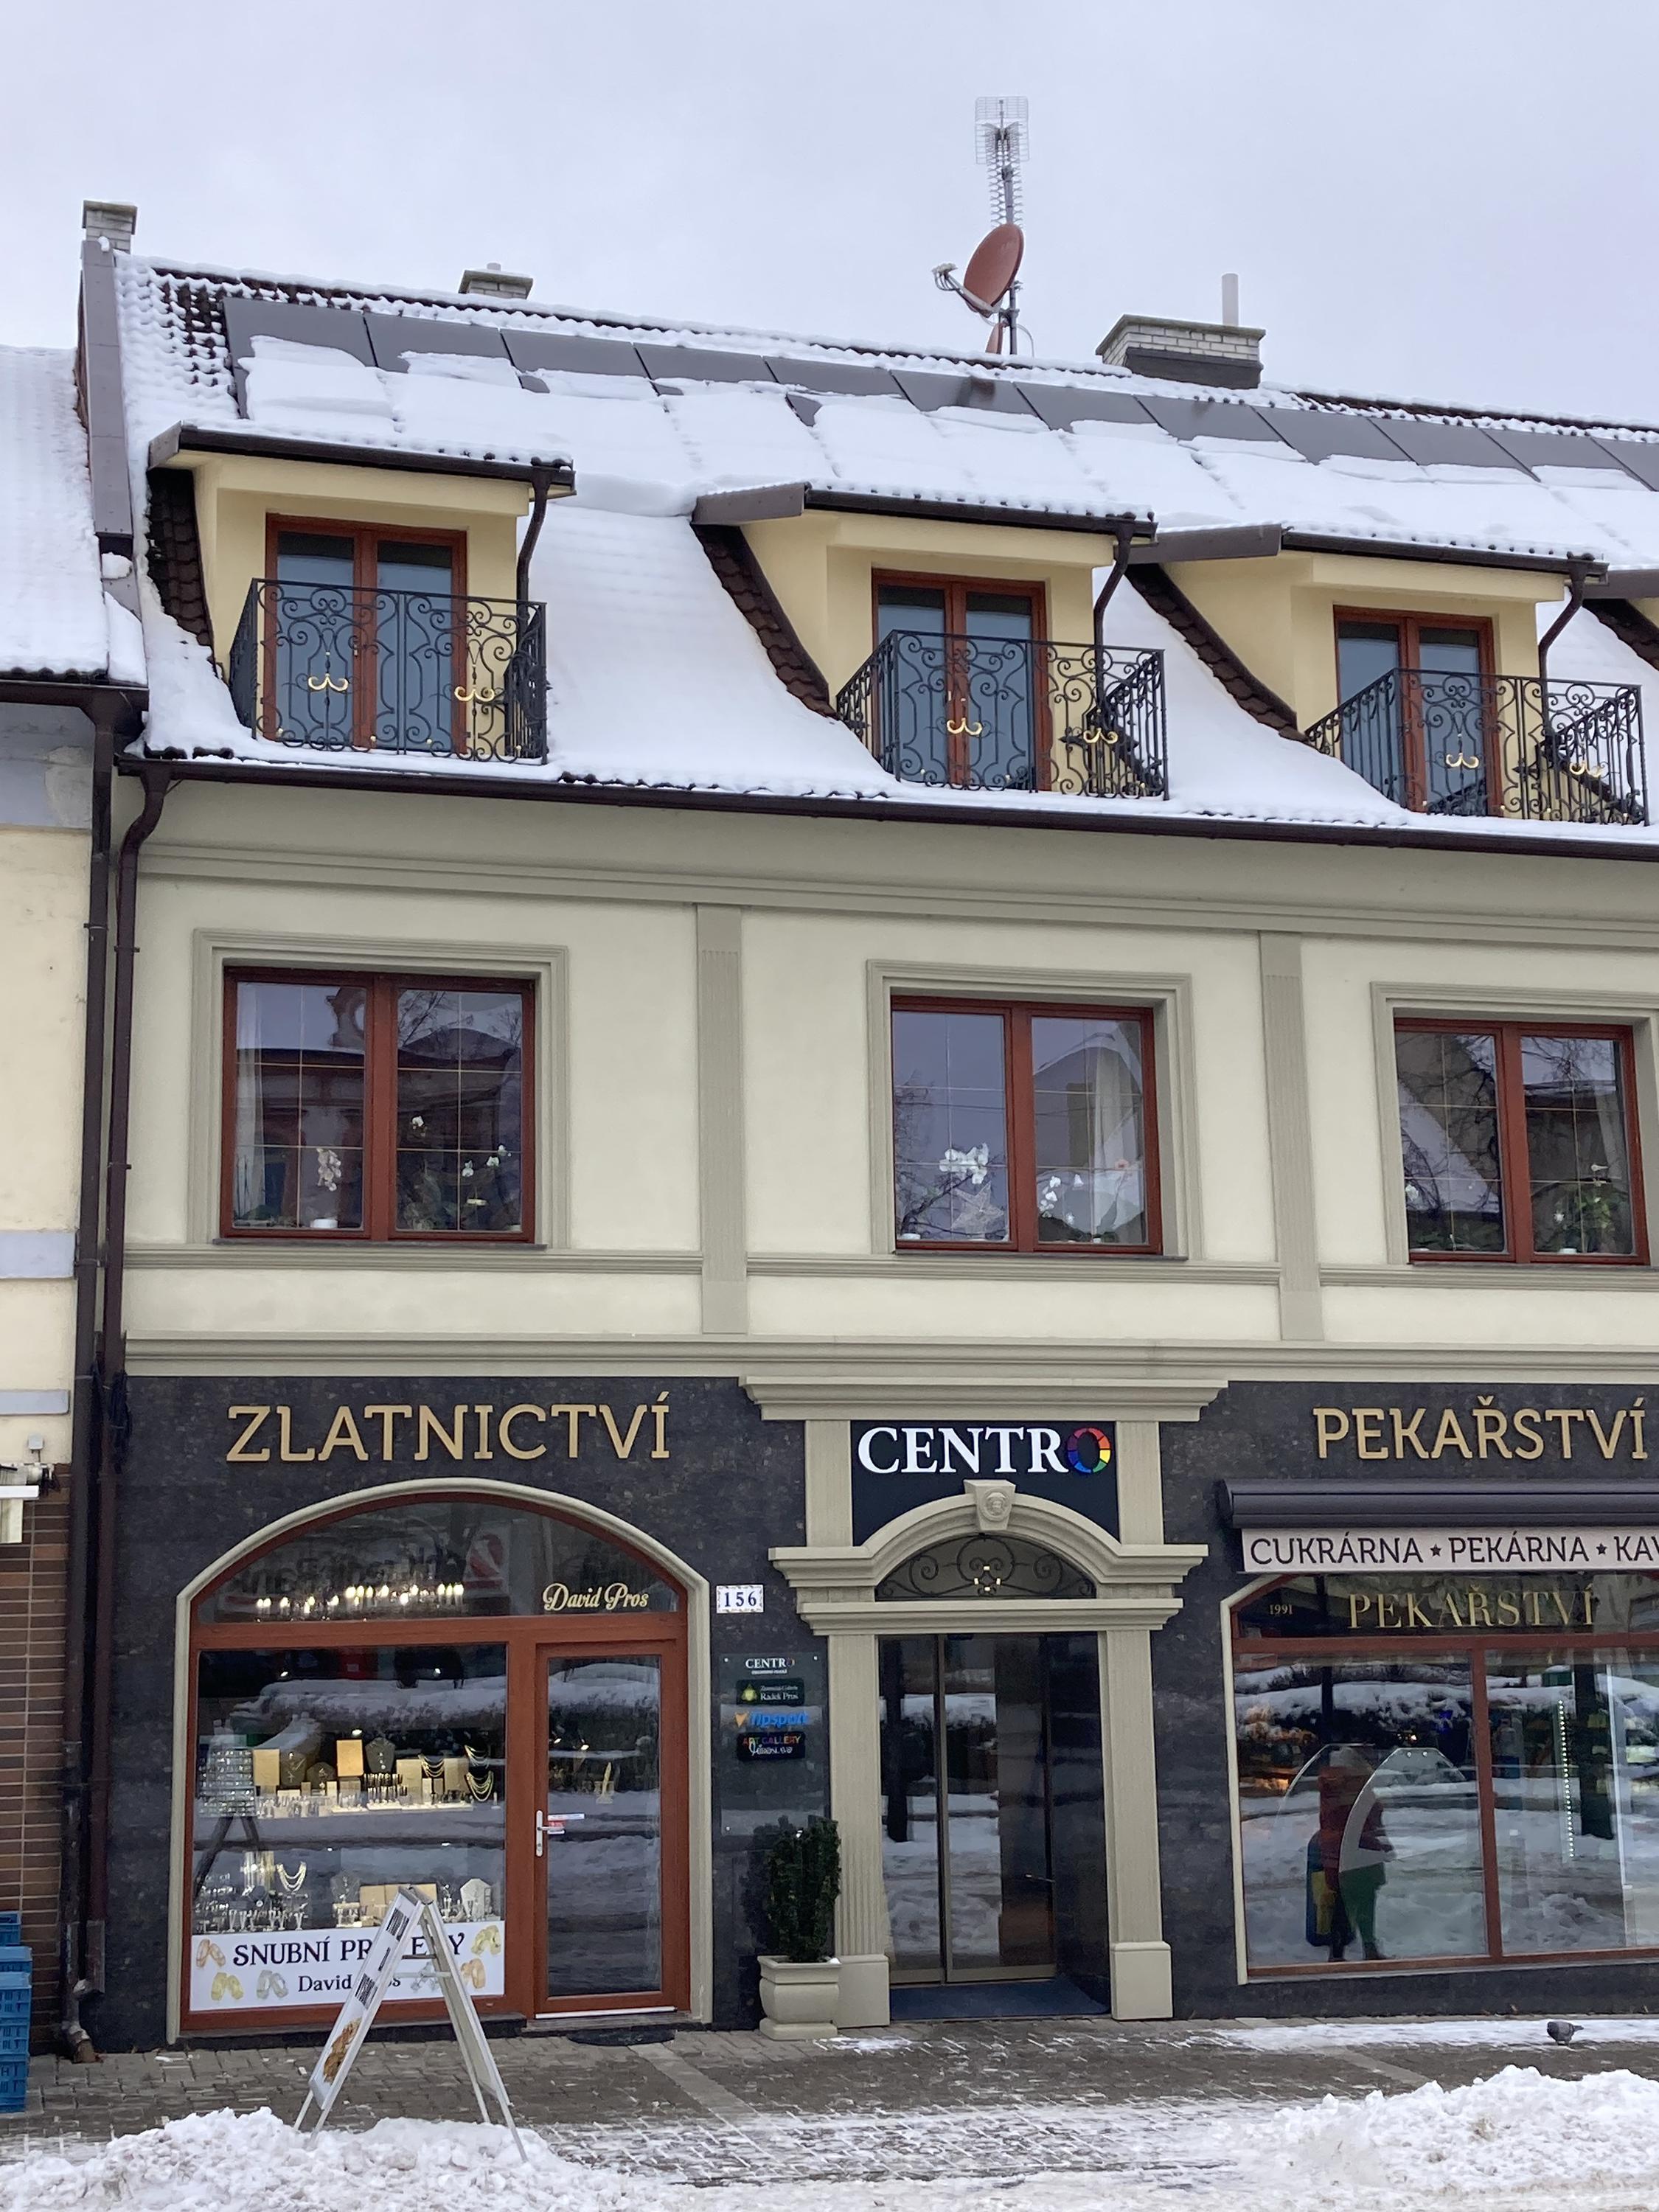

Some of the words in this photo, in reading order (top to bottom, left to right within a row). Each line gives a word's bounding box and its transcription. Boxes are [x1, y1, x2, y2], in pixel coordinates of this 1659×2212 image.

[226, 1391, 670, 1461] ZLATNICTVÍ
[1312, 1395, 1649, 1460] PEKAŘSTVÍ
[858, 1426, 1111, 1474] CENTRO
[1251, 1531, 1424, 1565] CUKRÁRNA
[1448, 1530, 1590, 1563] PEKÁRNA
[542, 1582, 602, 1611] David
[604, 1582, 649, 1611] Pros
[724, 1590, 757, 1607] 156
[1347, 1583, 1594, 1630] PEKAŘSTVÍ
[233, 1935, 330, 1966] SNUBNÍ
[340, 1932, 465, 1961] PREY
[298, 1974, 353, 1992] David
